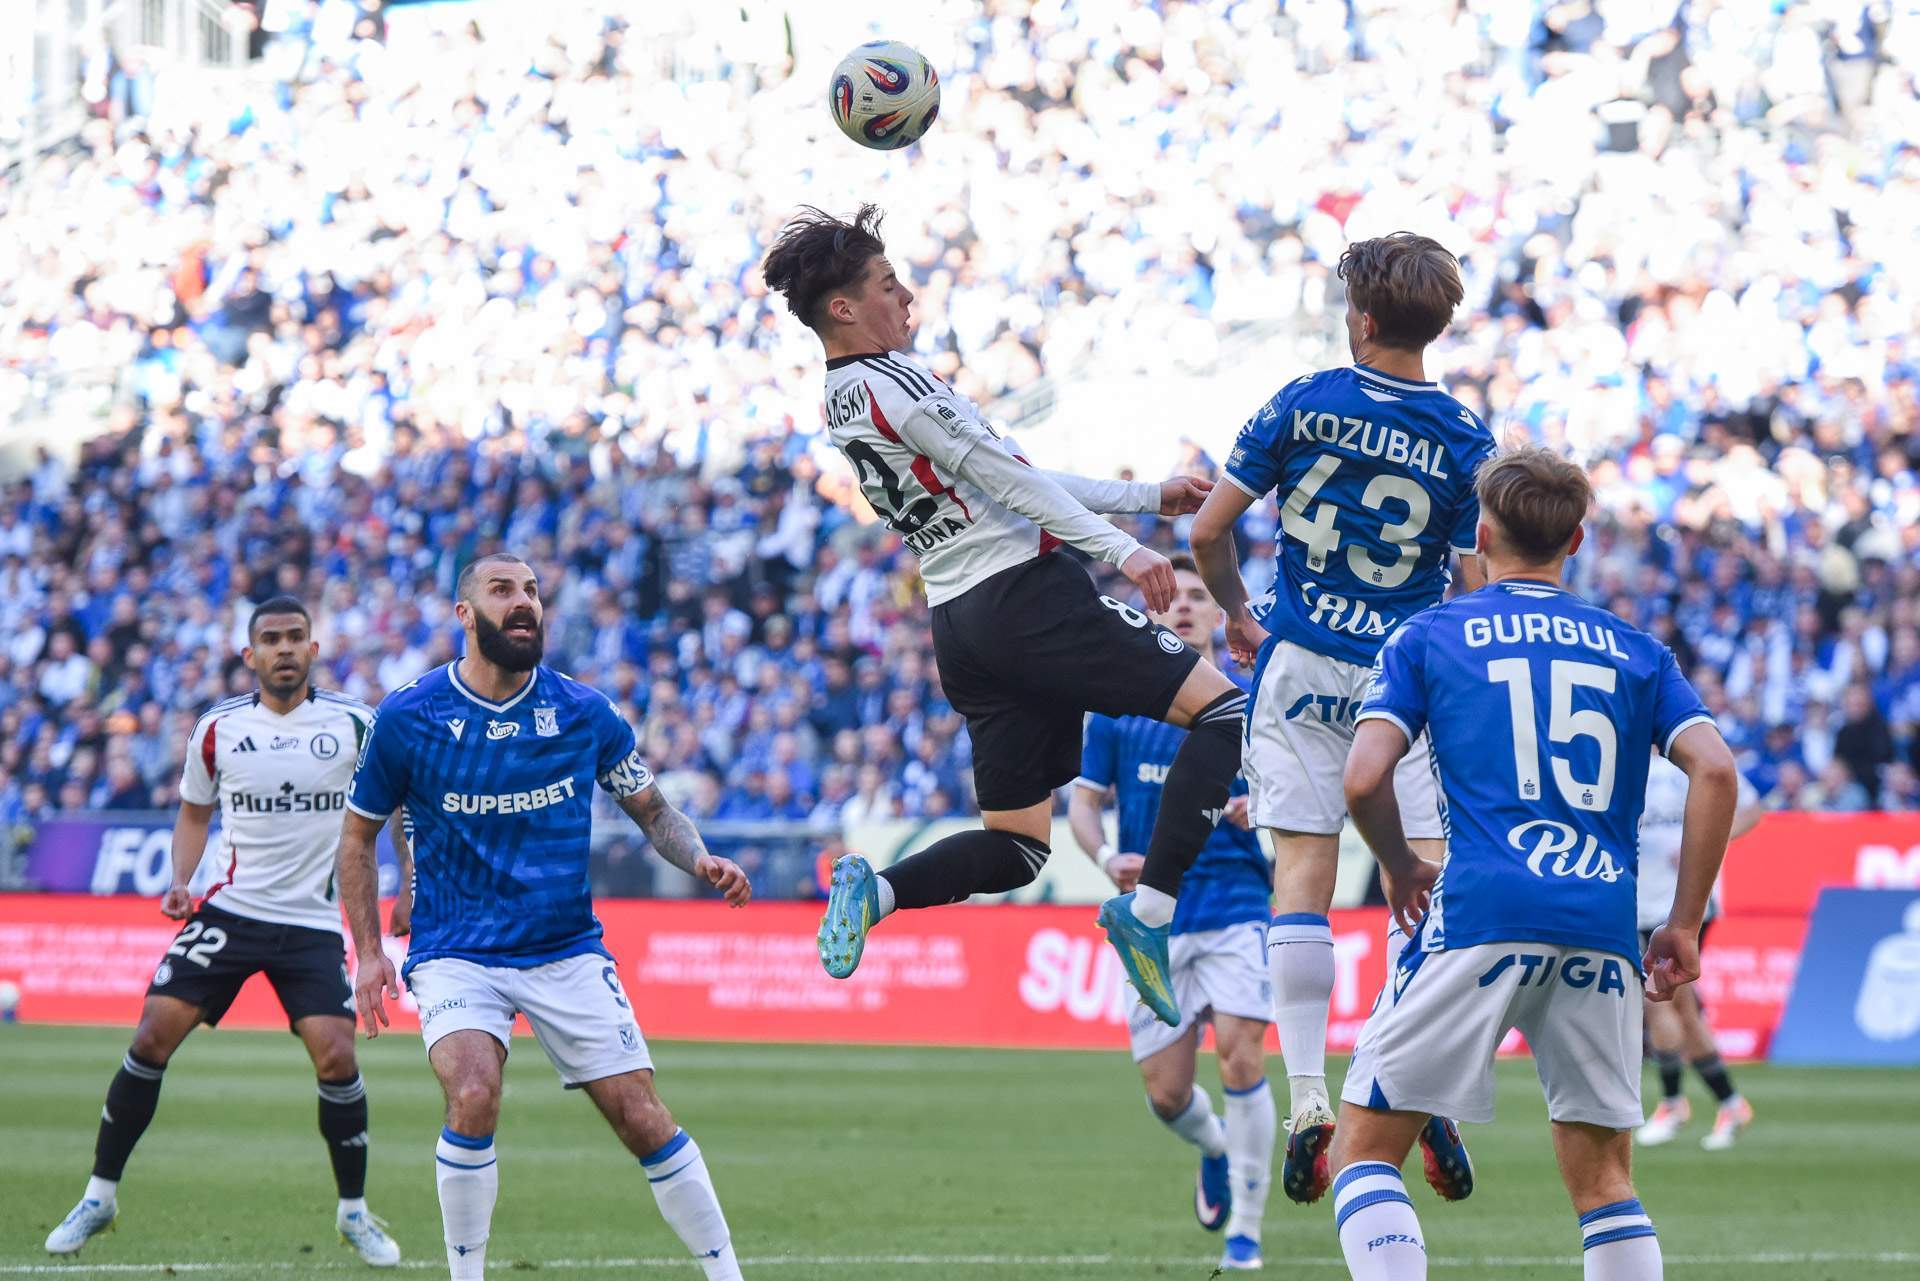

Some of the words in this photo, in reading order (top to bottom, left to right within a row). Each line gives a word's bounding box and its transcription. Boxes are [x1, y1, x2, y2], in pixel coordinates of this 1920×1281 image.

[825, 384, 866, 430] AŃSKI
[1293, 409, 1448, 480] KOZUBAL
[1280, 455, 1432, 588] 43
[1463, 613, 1630, 661] GURGUL
[1487, 658, 1617, 812] 15
[231, 791, 345, 813] Plus500
[442, 776, 575, 815] SUPERBET
[1507, 819, 1624, 883] Pils
[167, 920, 228, 968] 22
[1478, 954, 1626, 998] STIGA
[1368, 1234, 1418, 1251] FORZA
